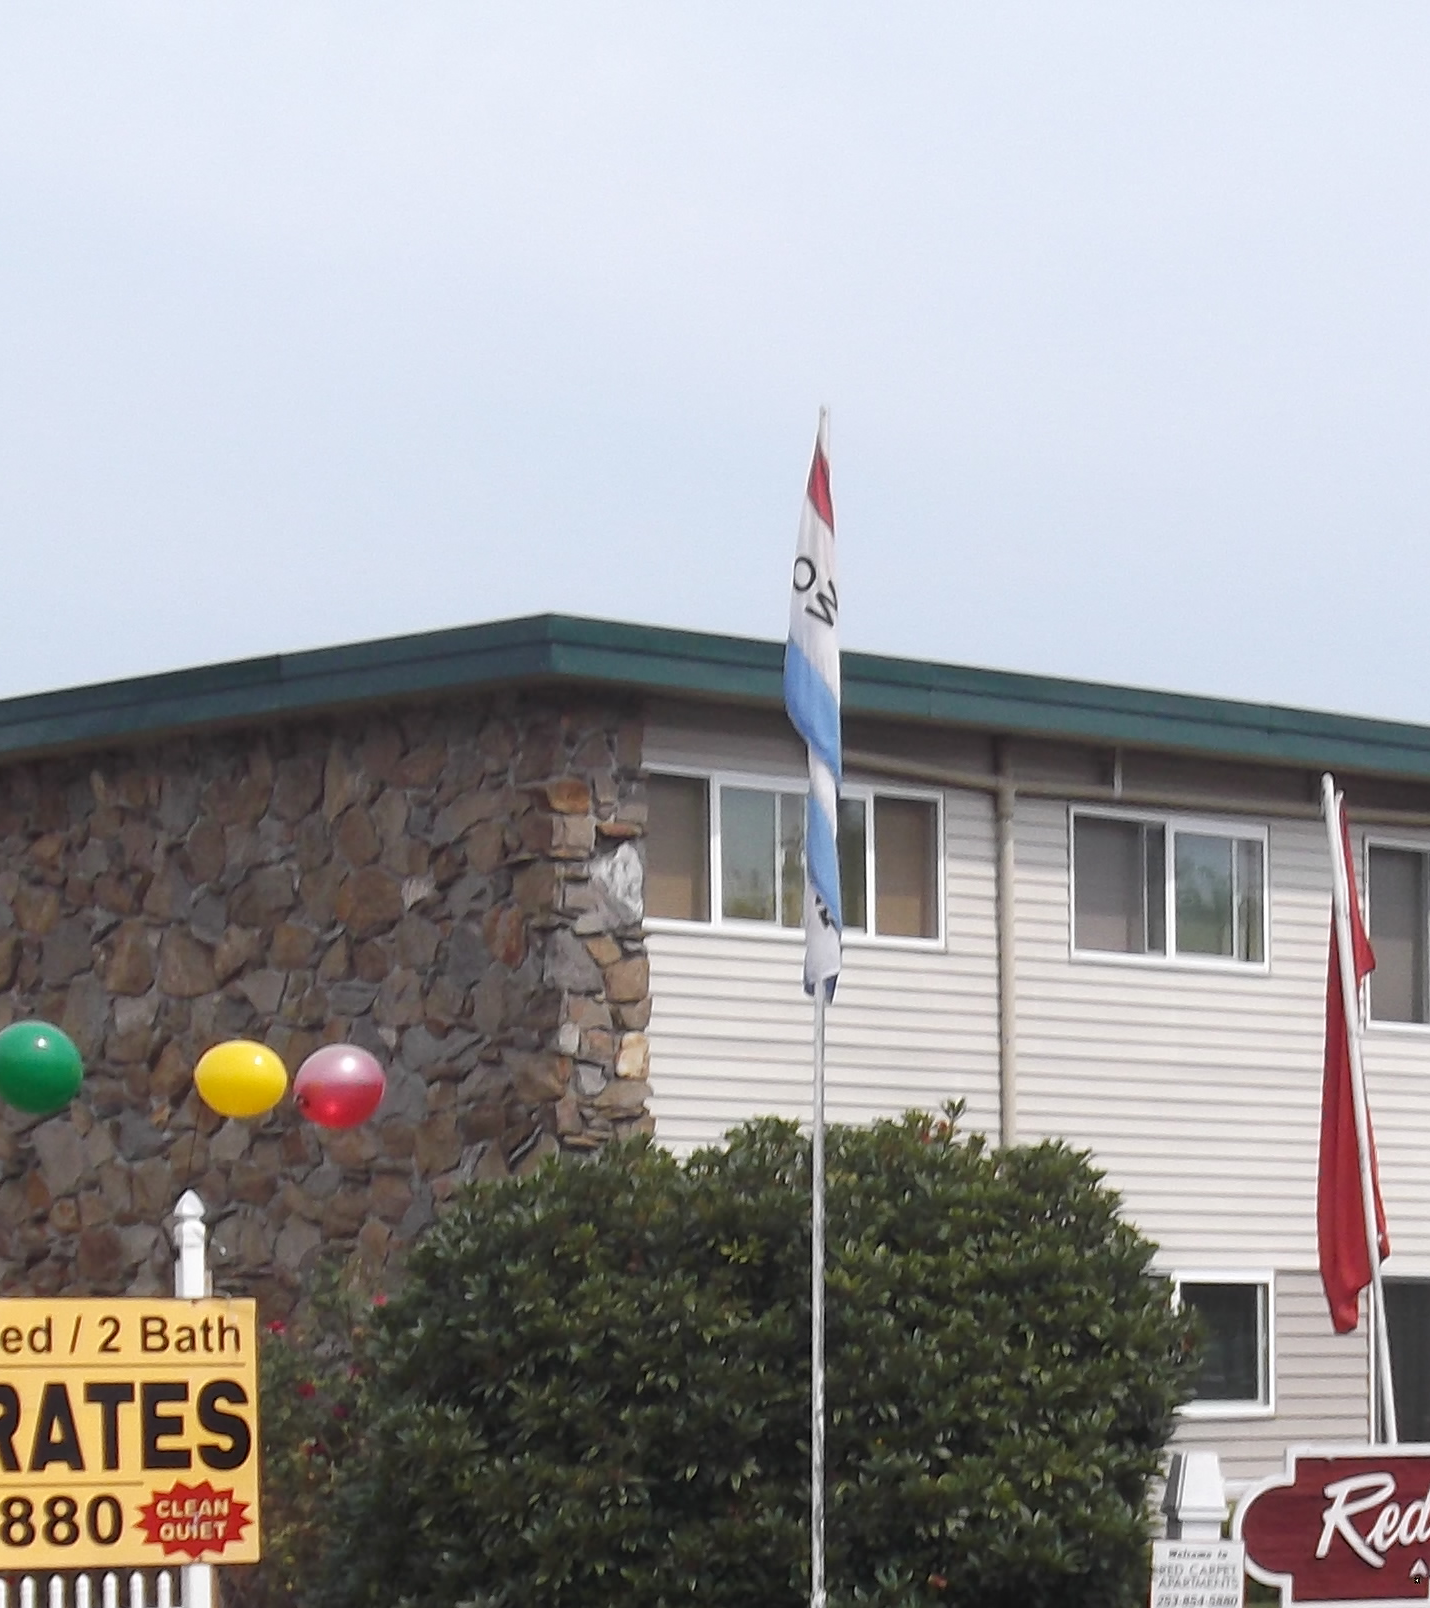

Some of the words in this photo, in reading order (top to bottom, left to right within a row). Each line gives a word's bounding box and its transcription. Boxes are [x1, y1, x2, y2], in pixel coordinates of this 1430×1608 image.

[68, 1316, 82, 1352] /
[97, 1315, 122, 1353] 2
[139, 1314, 241, 1354] Bath
[155, 1497, 229, 1519] CLEAN
[1168, 1548, 1212, 1559] Welcome
